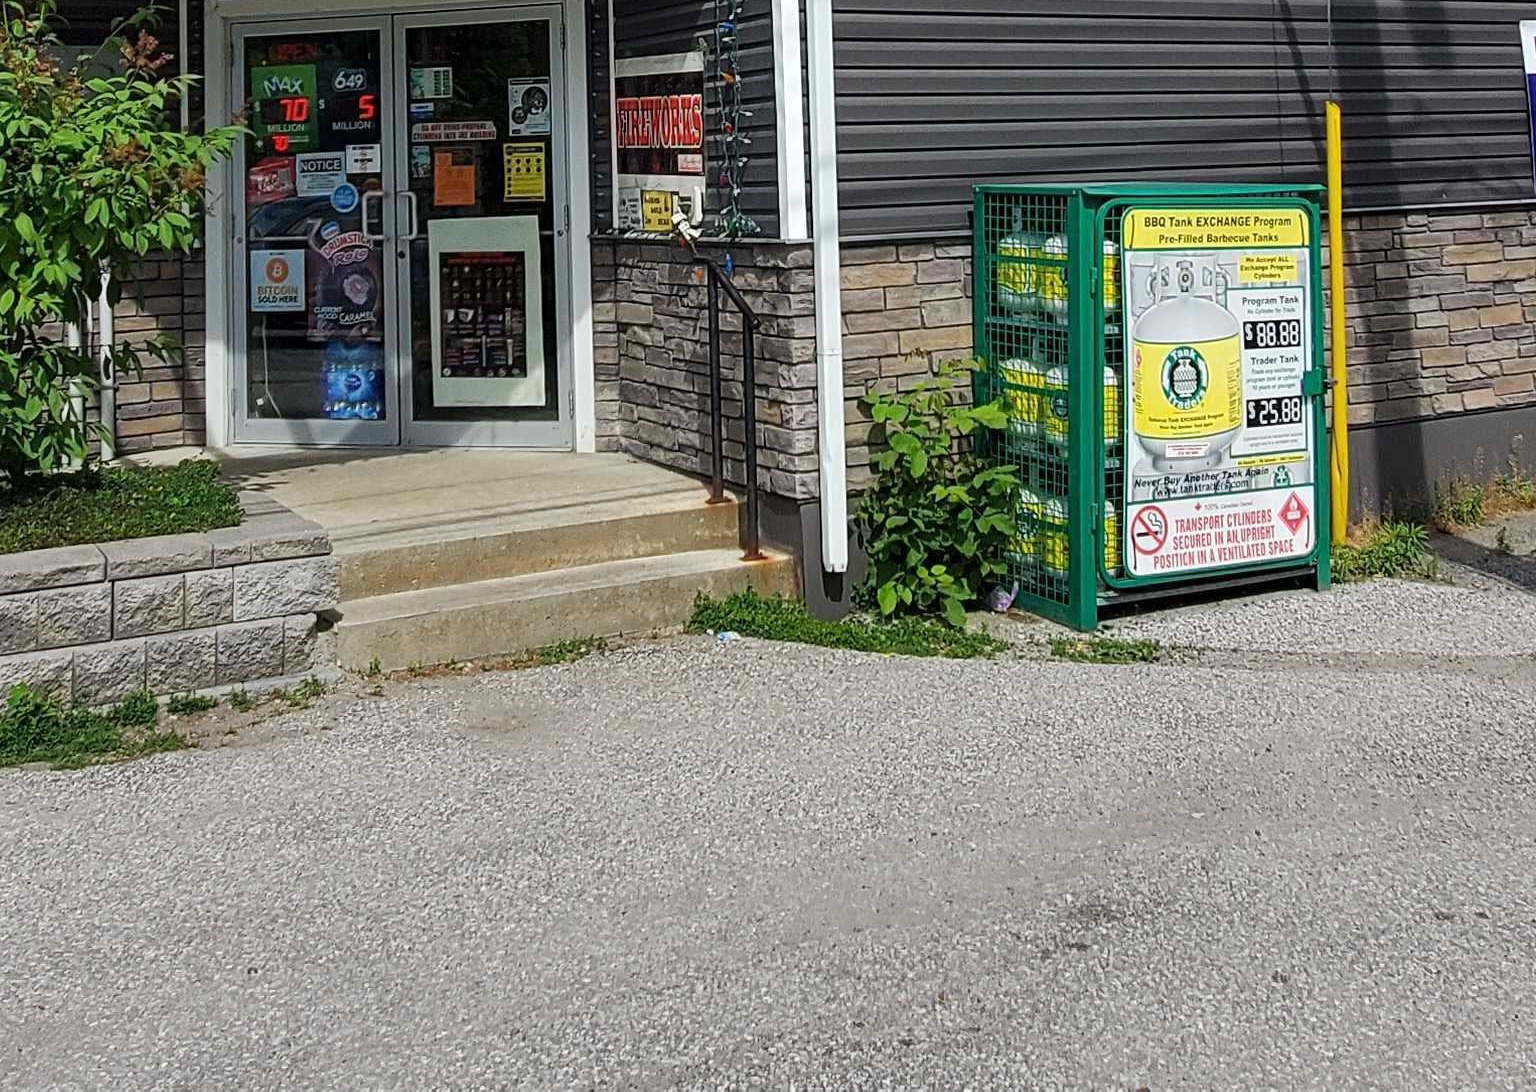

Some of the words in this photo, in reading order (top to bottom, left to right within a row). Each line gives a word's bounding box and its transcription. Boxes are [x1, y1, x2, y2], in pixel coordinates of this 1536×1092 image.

[334, 70, 364, 88] 649
[280, 98, 309, 121] 70
[358, 95, 375, 119] 5
[267, 123, 305, 133] MILLION
[332, 121, 371, 130] MILLION
[617, 94, 703, 148] FIREWORKS
[301, 160, 341, 172] NOTICE
[1144, 216, 1166, 228] BBQ
[1169, 216, 1193, 227] Tank
[1196, 215, 1250, 227] EXCHANGE
[1253, 216, 1292, 229] Program
[321, 231, 373, 258] DRUMSTICK
[1159, 234, 1204, 244] Pre-Filled
[1206, 233, 1251, 243] Barbecue
[1253, 232, 1279, 242] Tanks
[257, 286, 299, 296] BITCOIN
[1242, 297, 1277, 306] Program
[1280, 295, 1299, 304] Tank
[1245, 323, 1253, 341] $
[1256, 321, 1300, 347] 88.88
[1171, 348, 1197, 359] Tank
[1250, 355, 1277, 365] Trader
[1279, 354, 1299, 364] Tank
[1169, 390, 1206, 410] Traders
[1248, 401, 1255, 419] $
[1260, 398, 1300, 424] 25.88
[1134, 477, 1161, 488] Never
[1164, 475, 1181, 486] Buy
[1184, 471, 1220, 483] Another
[1223, 470, 1242, 478] Tank
[1245, 467, 1270, 478] Again
[1175, 514, 1224, 533] TRANSPORT
[1227, 509, 1272, 527] CYLINDERS
[1173, 532, 1212, 550] SECURED
[1215, 532, 1224, 545] IN
[1226, 530, 1238, 544] AN
[1240, 525, 1275, 543] UPRIGHT
[1153, 550, 1195, 570] POSITION
[1197, 551, 1207, 564] IN
[1209, 549, 1216, 562] A
[1217, 542, 1266, 562] VENTILATED
[1268, 538, 1294, 554] SPACE
